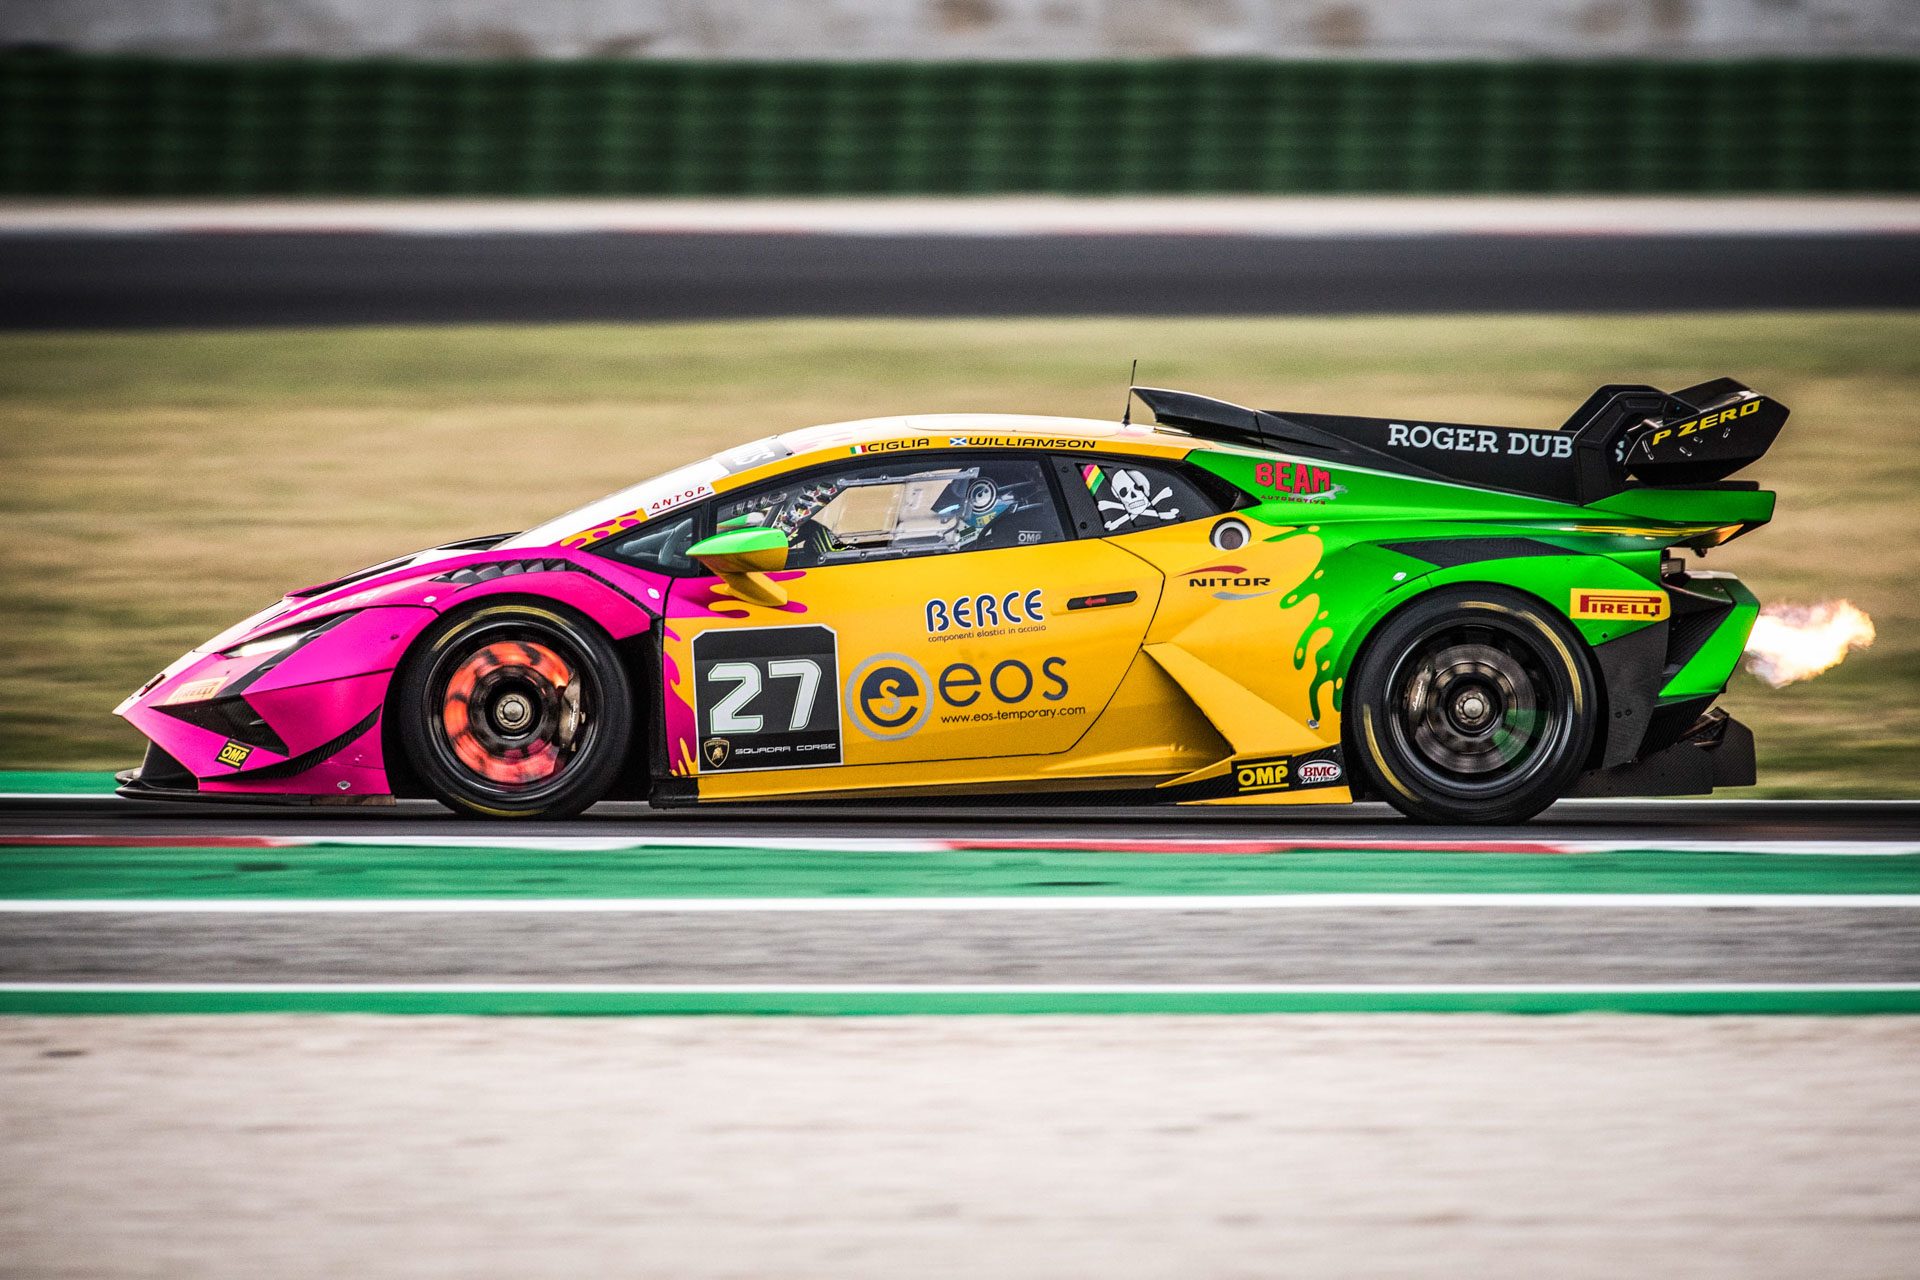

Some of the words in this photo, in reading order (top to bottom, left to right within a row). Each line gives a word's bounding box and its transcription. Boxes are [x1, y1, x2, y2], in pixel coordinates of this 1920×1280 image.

[1652, 429, 1672, 446] P
[1677, 400, 1761, 437] ZERO
[867, 438, 930, 452] CIGLIA
[968, 436, 1096, 449] WILLIAMSON
[1387, 423, 1499, 453] ROGER
[1255, 461, 1331, 494] BEAM
[1017, 531, 1042, 541] OMP
[1189, 577, 1271, 587] NITOR
[926, 588, 1044, 632] BERCE
[1580, 594, 1662, 615] PIRELLI
[928, 632, 975, 643] componenti
[976, 629, 1006, 638] elastici
[1017, 625, 1047, 634] acciaio
[938, 656, 1069, 707] eos
[707, 658, 823, 735] 27
[940, 704, 1086, 723] www.eos-temporary.com
[221, 746, 247, 762] OMP
[735, 745, 791, 755] SQUADRA
[796, 743, 837, 752] CORSE
[1237, 765, 1289, 787] OMP
[1303, 766, 1337, 777] BMC
